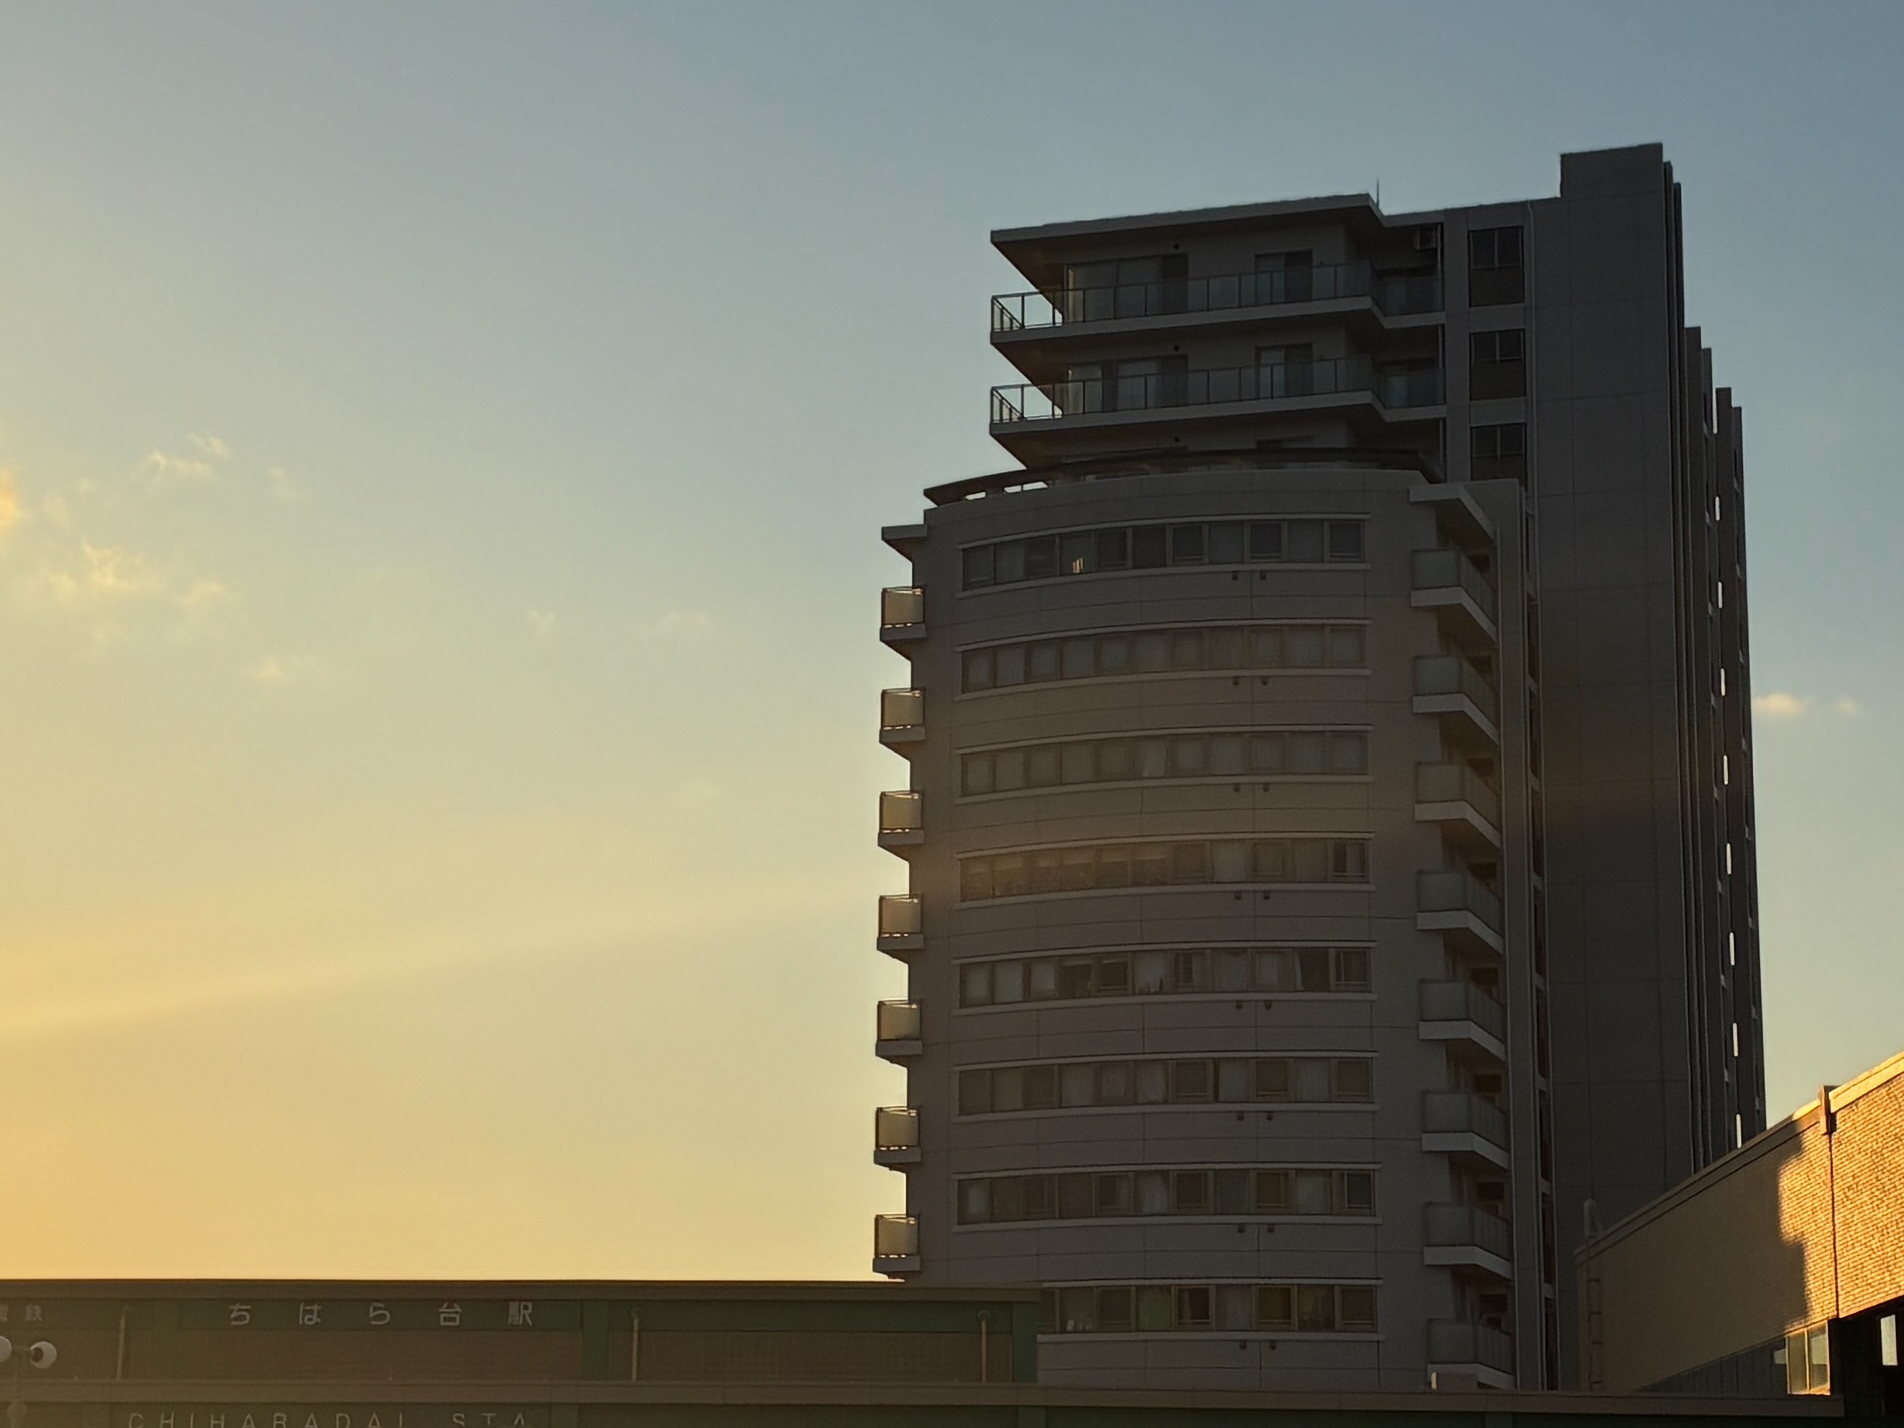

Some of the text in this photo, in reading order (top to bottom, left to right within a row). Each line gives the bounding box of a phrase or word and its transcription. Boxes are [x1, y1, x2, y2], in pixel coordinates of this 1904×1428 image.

[228, 1301, 533, 1326] ちはら台駅
